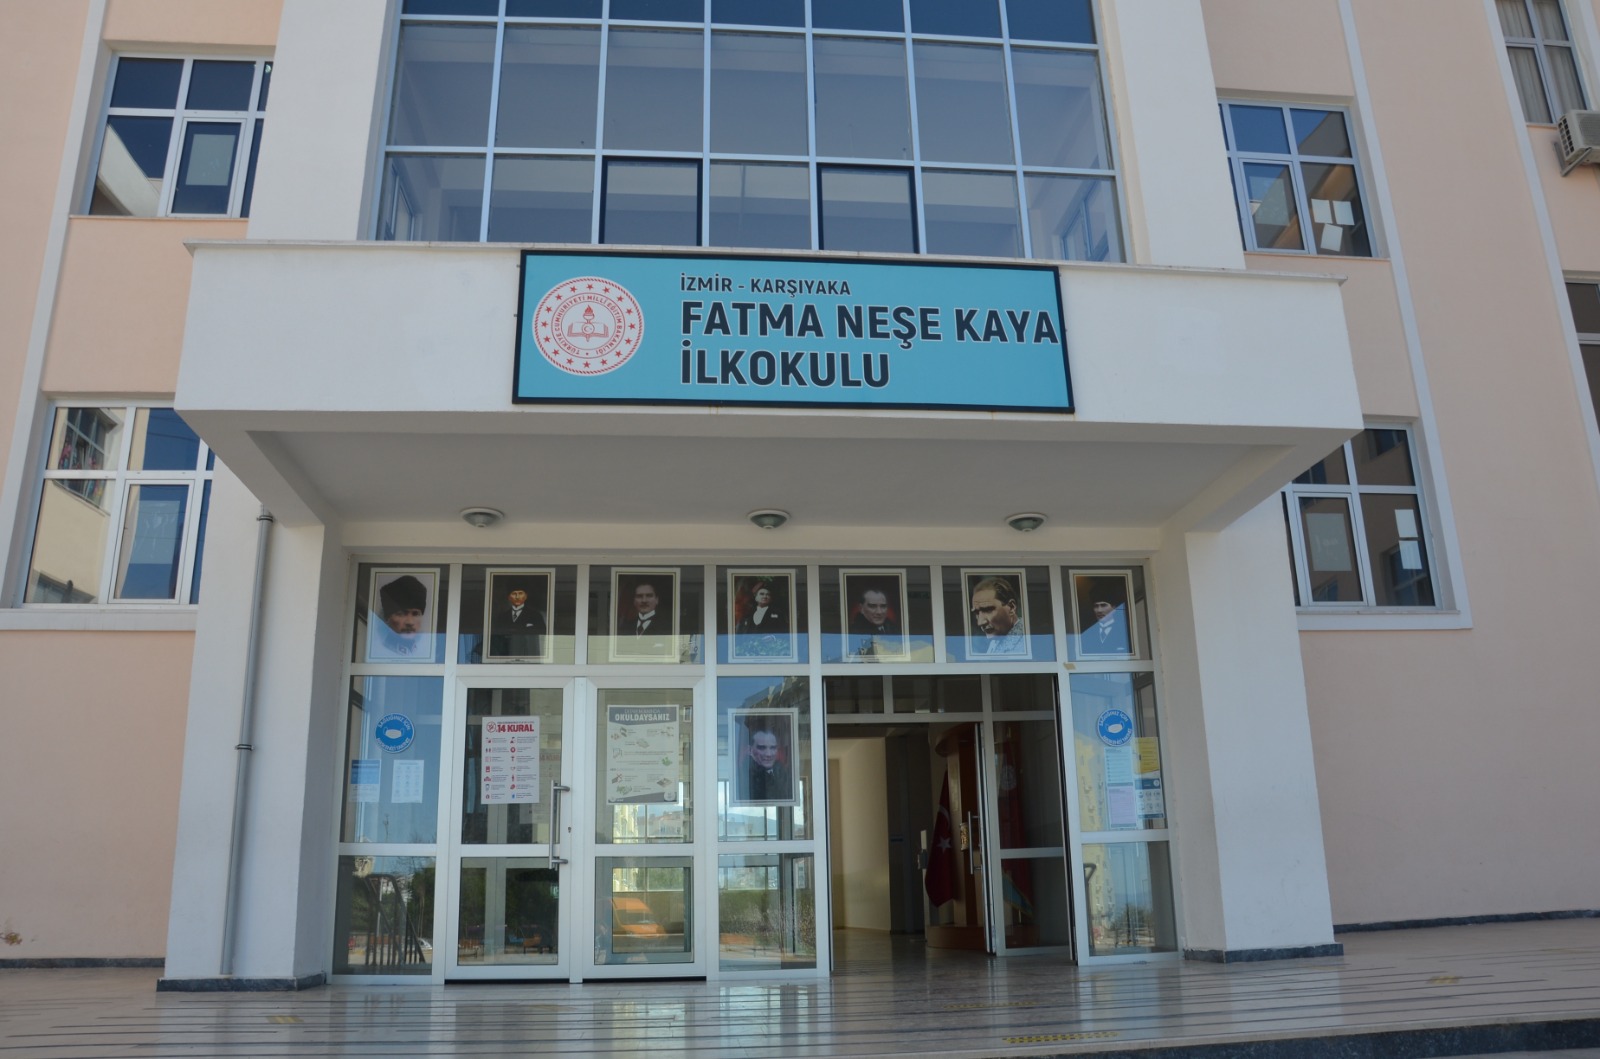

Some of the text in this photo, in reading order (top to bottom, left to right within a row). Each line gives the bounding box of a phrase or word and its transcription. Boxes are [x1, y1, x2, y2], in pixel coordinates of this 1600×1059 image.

[680, 272, 733, 292] İZMİR
[751, 278, 851, 298] KARŞIYAKA
[681, 301, 1060, 349] FATMA NEŞE KAYA
[681, 339, 890, 388] İLKOKULU
[497, 724, 534, 733] 14 KURAL
[614, 713, 670, 721] OKULDAYSANIZ
